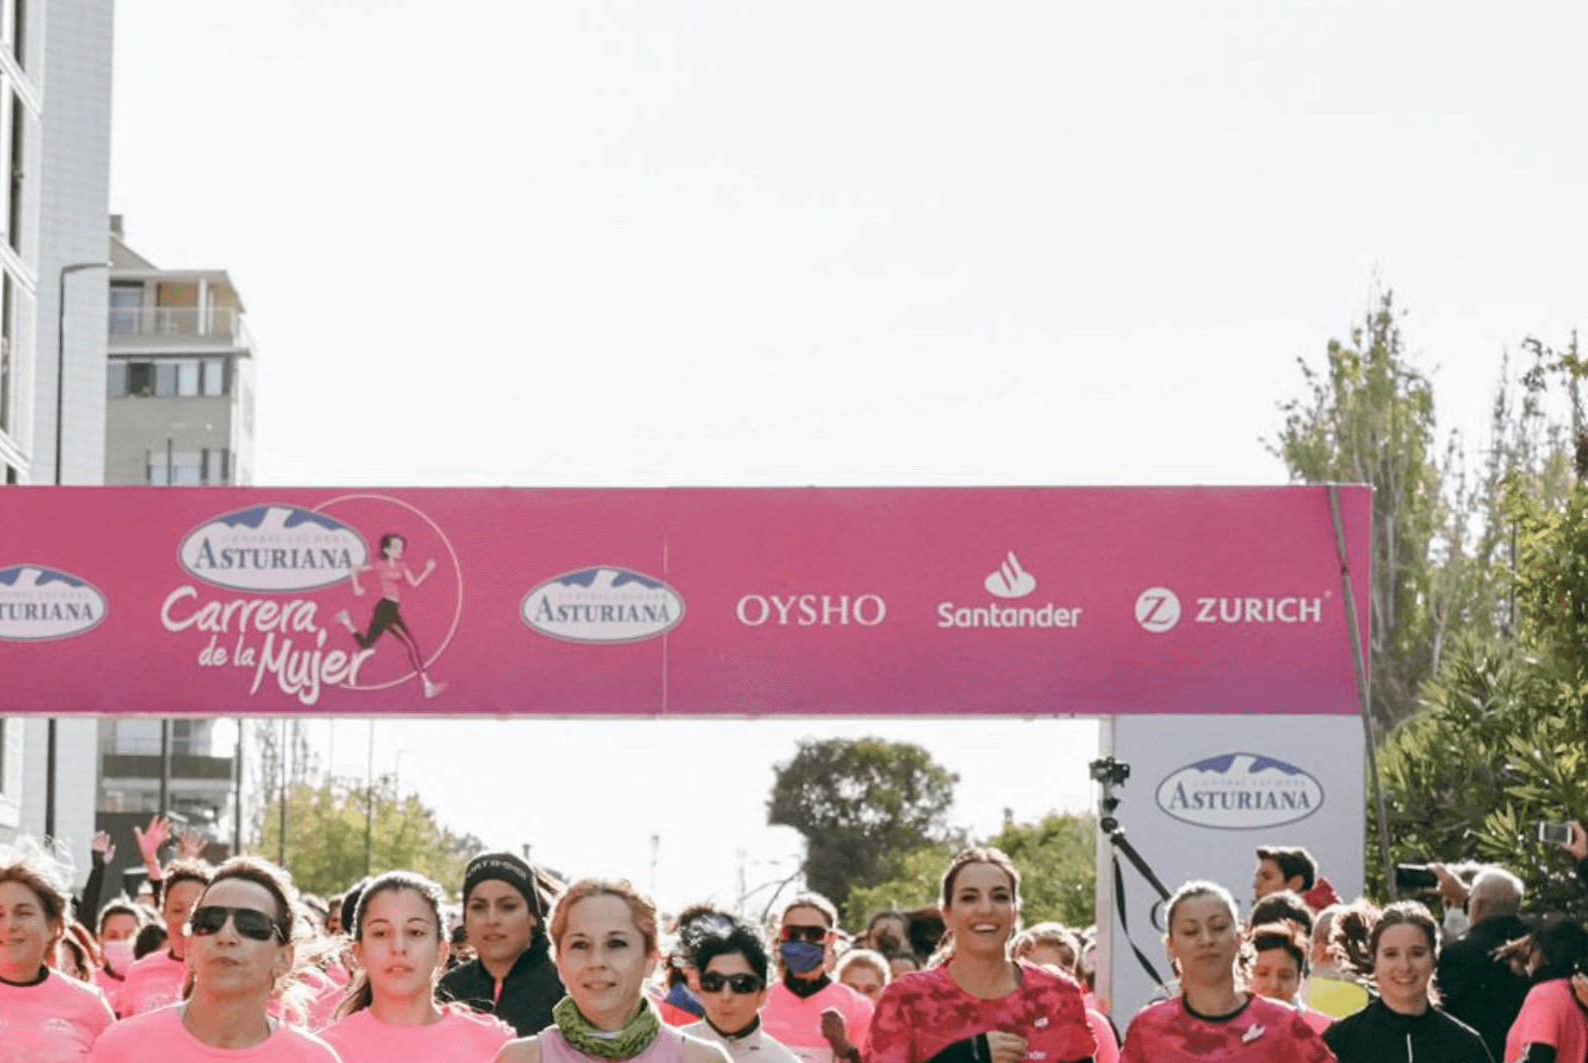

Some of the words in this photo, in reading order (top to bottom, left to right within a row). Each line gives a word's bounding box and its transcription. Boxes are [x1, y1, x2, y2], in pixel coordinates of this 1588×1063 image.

[193, 534, 354, 570] ASTURIANA
[160, 585, 319, 633] Carrera
[534, 594, 671, 624] ASTURIANA
[736, 595, 887, 626] OYSHO
[937, 600, 1083, 629] Santander
[1195, 597, 1323, 624] ZURICH
[198, 635, 229, 667] de
[233, 633, 256, 667] la
[250, 632, 377, 705] Mujer
[1168, 781, 1311, 810] ASTURIANA
